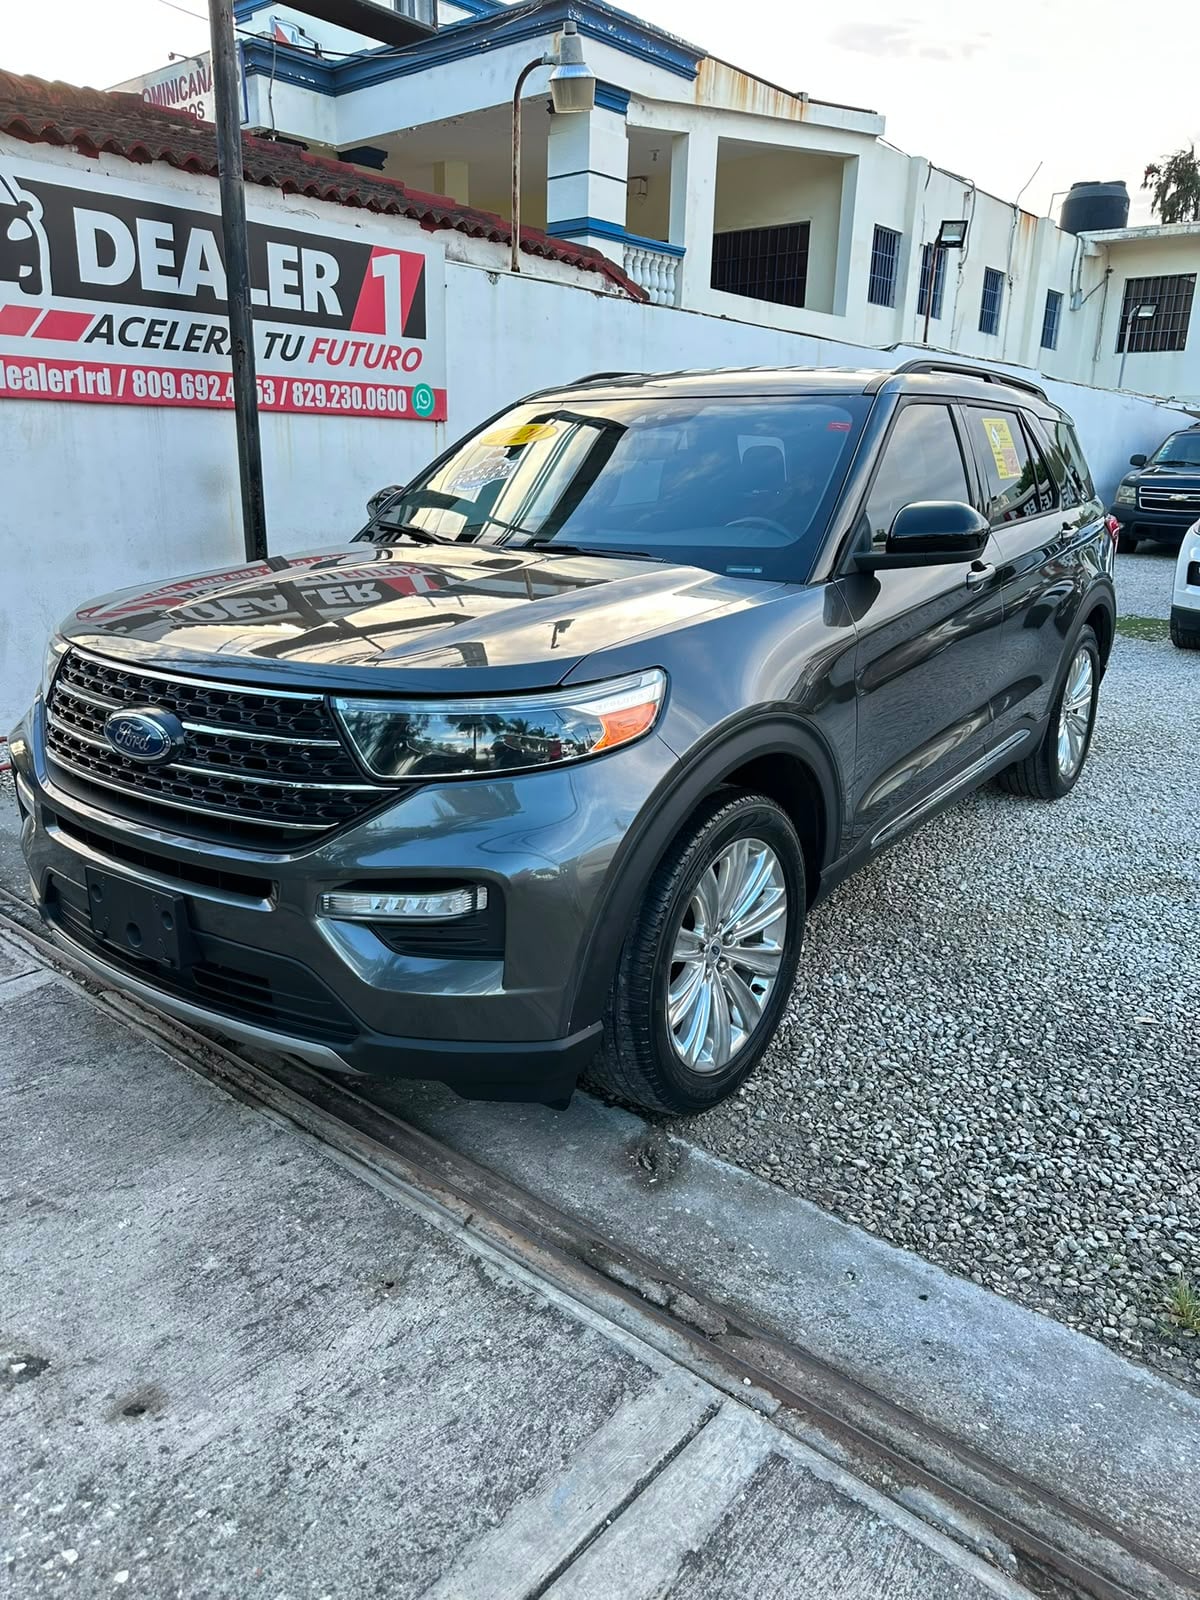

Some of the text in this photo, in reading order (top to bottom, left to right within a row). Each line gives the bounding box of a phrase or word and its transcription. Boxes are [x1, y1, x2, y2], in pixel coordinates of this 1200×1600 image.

[371, 253, 403, 337] 1
[84, 313, 422, 372] ACELER TU FUTURO
[132, 369, 275, 405] 809.692.453
[292, 382, 407, 412] 829.230.0600
[115, 721, 152, 751] Ford
